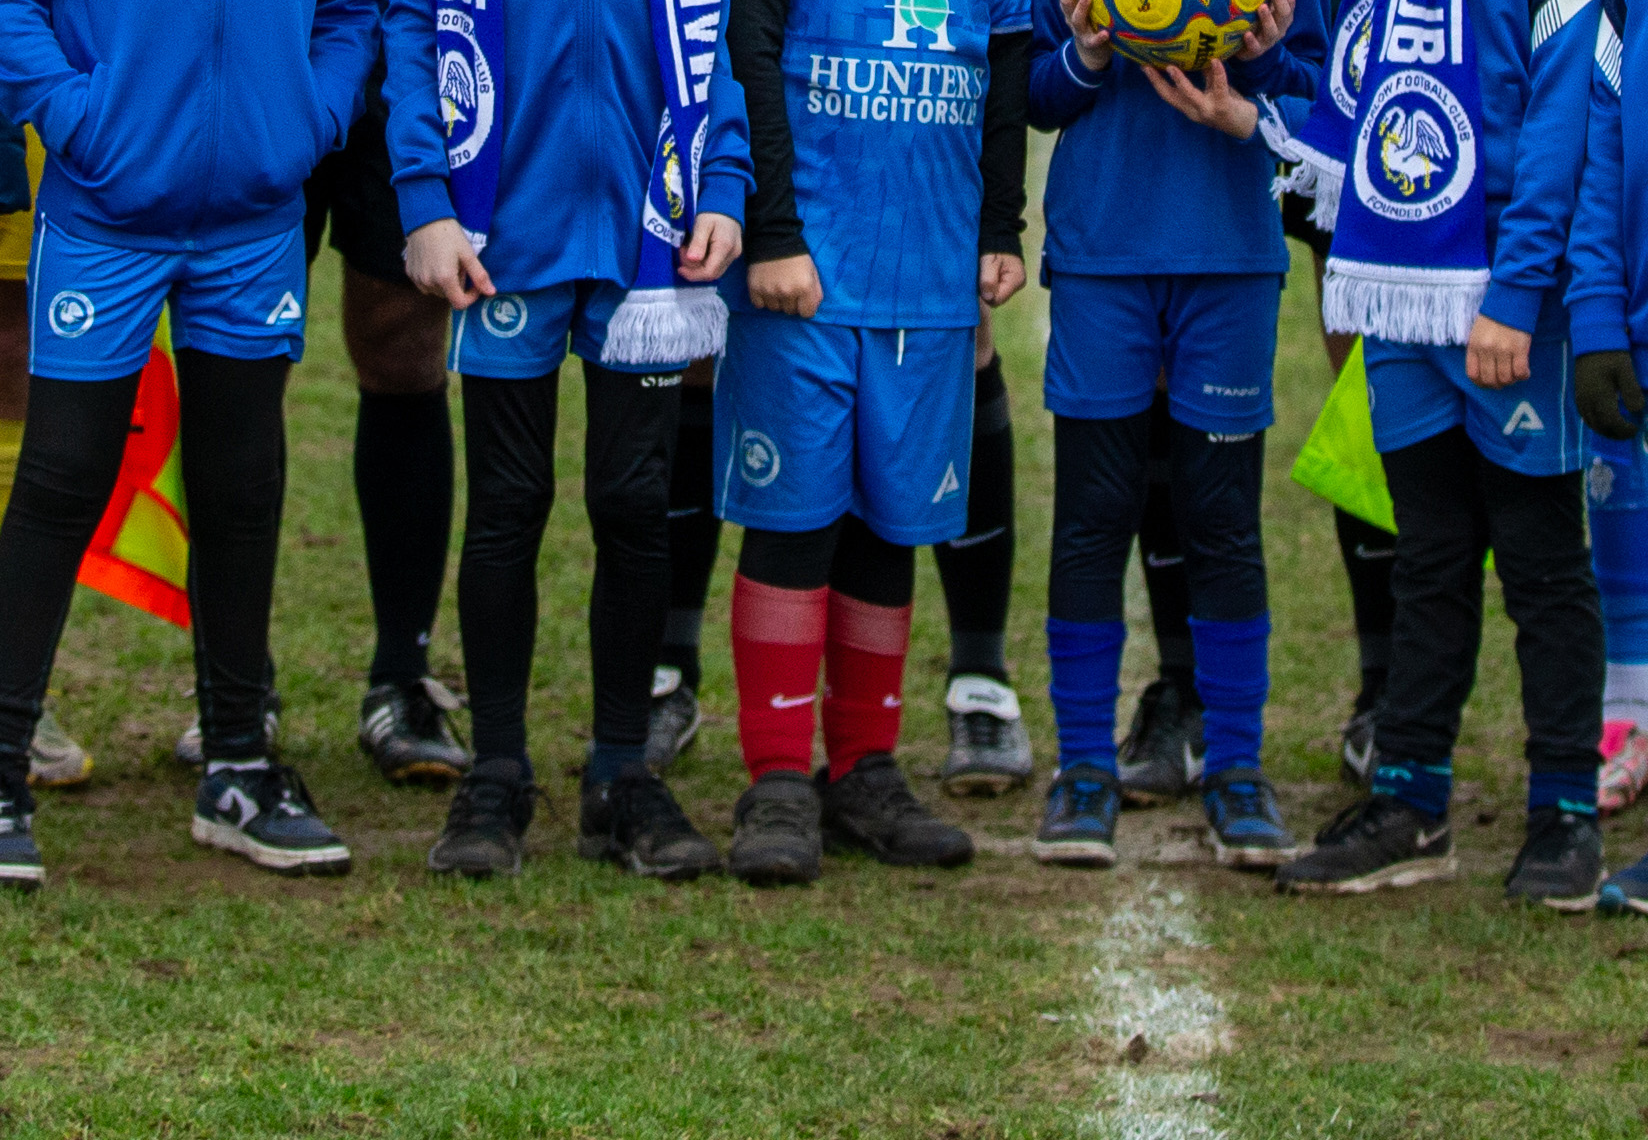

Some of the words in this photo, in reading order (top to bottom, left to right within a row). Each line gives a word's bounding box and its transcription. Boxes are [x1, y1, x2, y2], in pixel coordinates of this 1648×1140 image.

[807, 53, 986, 101] HUNTER'S
[807, 89, 962, 126] SOLICITORS
[1362, 84, 1394, 141] MARLOW
[1394, 74, 1450, 108] FOOTBALL
[1448, 104, 1471, 142] CLUB
[1366, 194, 1423, 219] FOUNDED
[1425, 196, 1453, 216] 1870
[1202, 383, 1261, 397] STANNO
